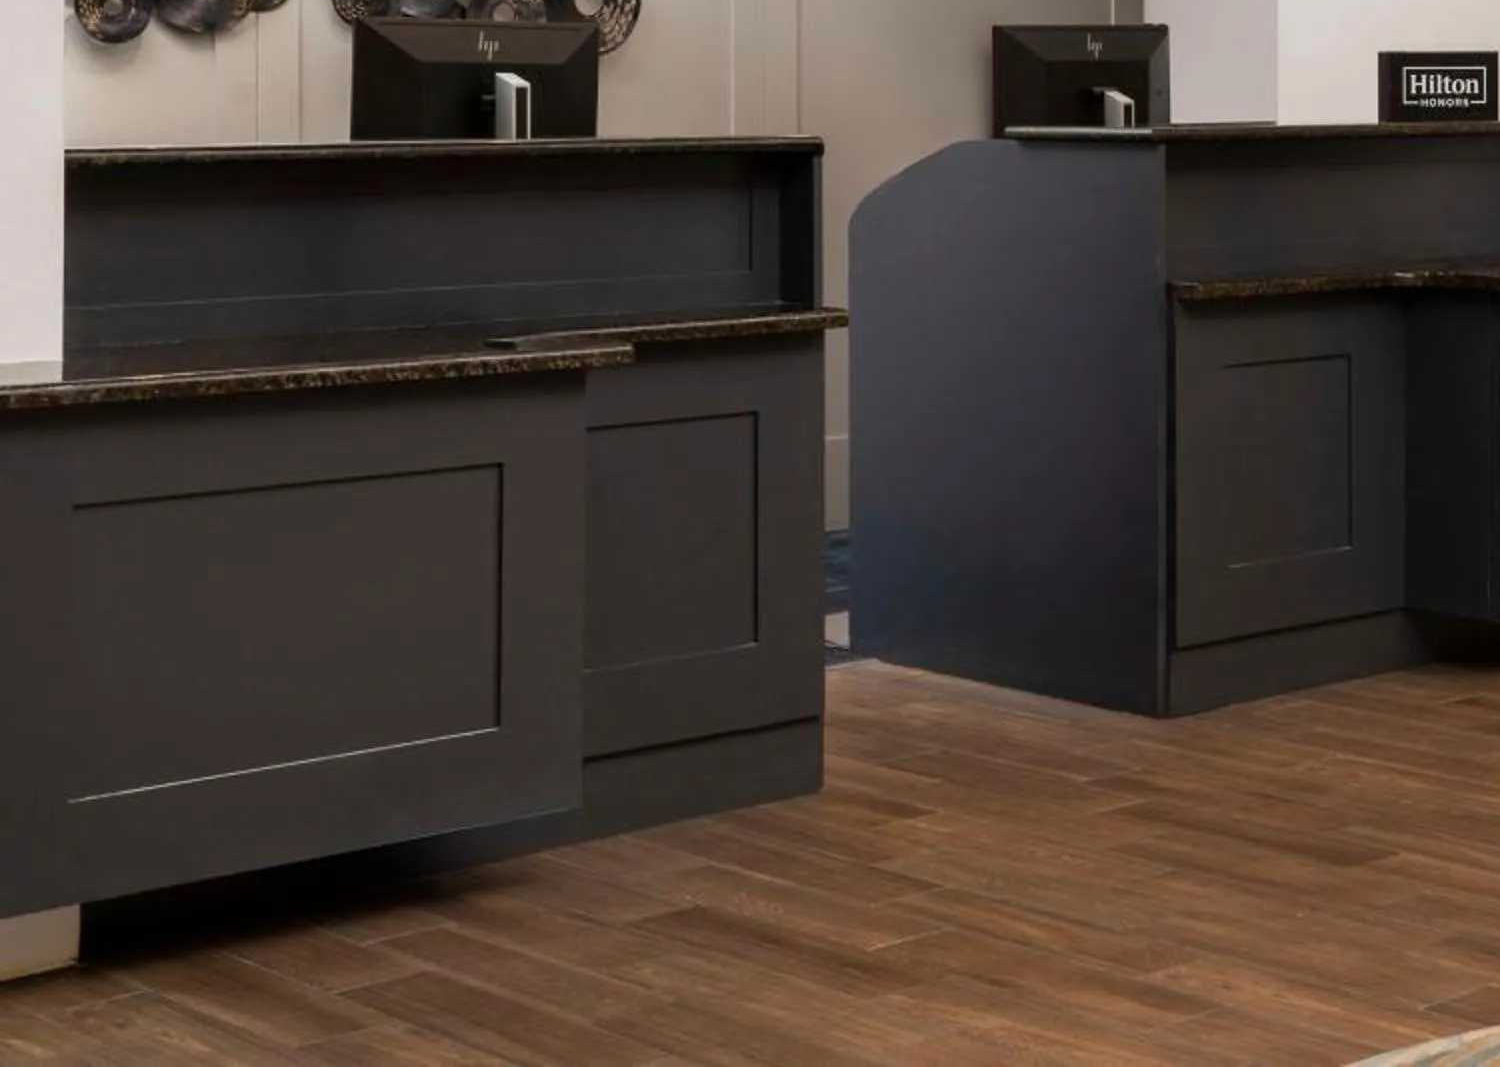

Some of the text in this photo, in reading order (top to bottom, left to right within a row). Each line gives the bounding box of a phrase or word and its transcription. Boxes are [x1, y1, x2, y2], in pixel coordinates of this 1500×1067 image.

[478, 30, 500, 61] hp
[1409, 74, 1479, 94] Hilton
[1420, 98, 1469, 107] HONORS
